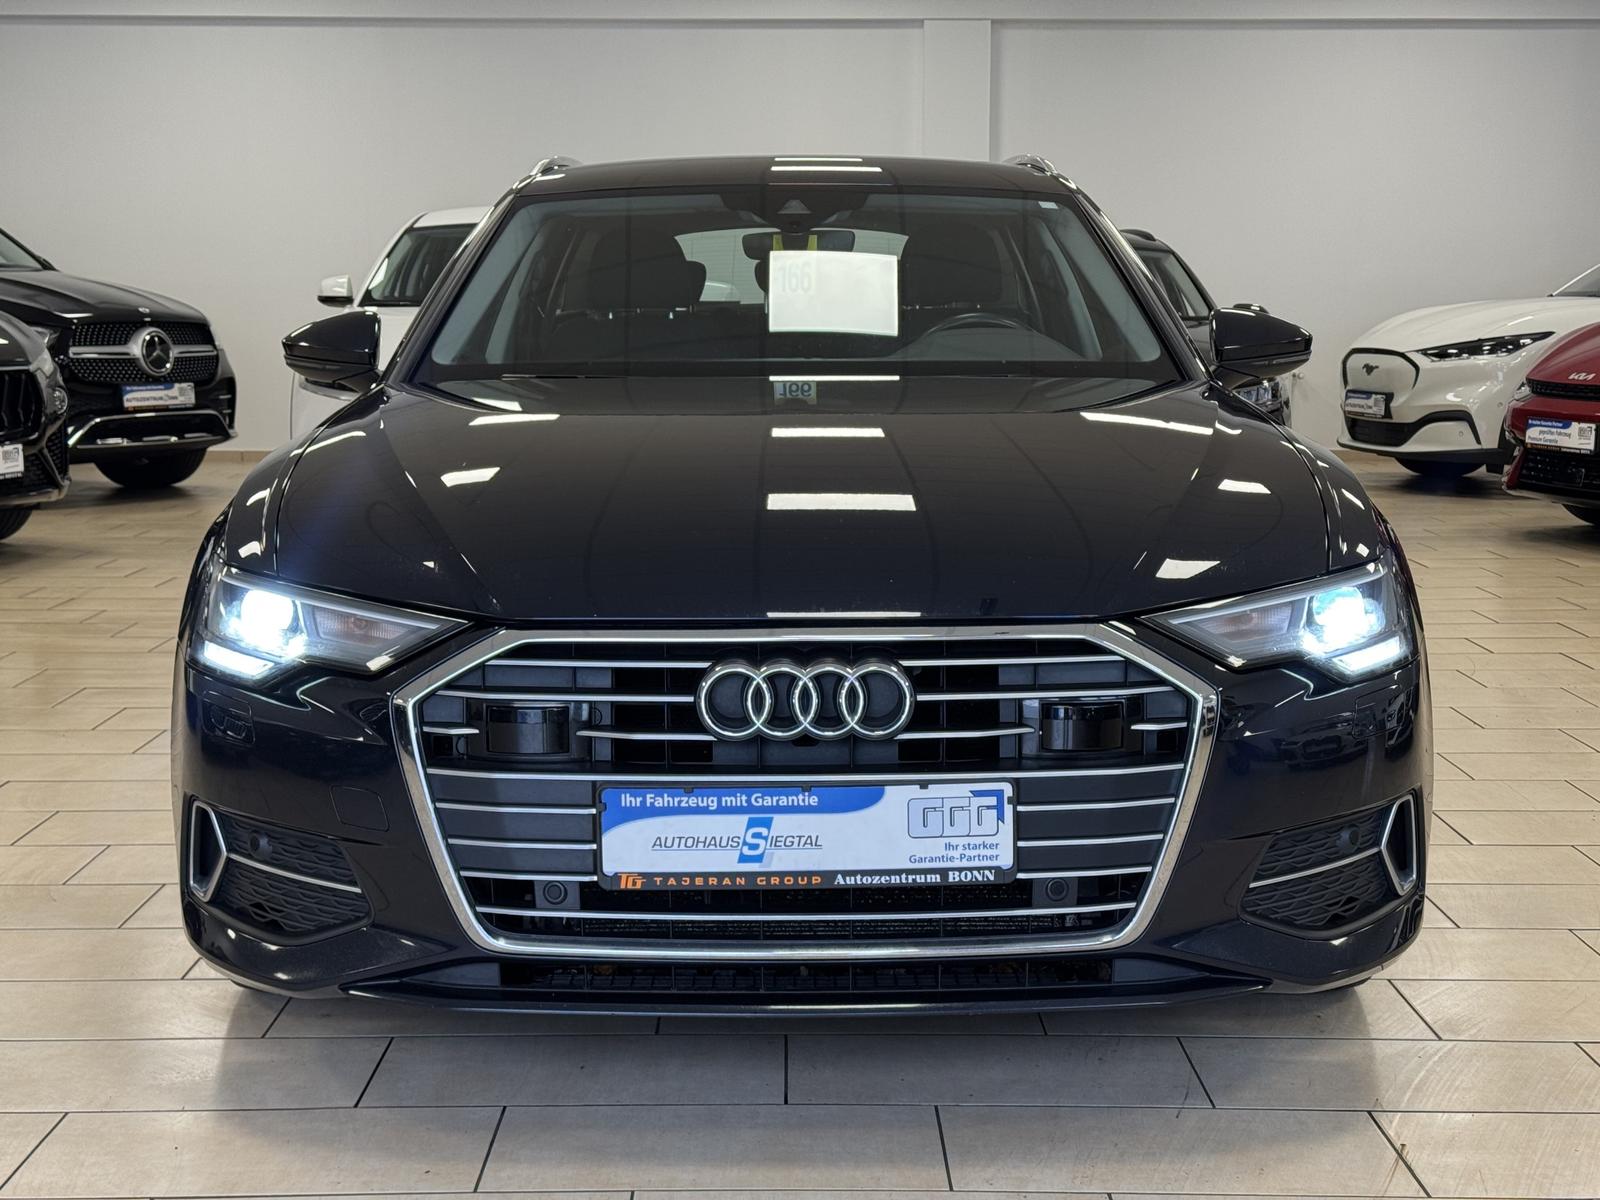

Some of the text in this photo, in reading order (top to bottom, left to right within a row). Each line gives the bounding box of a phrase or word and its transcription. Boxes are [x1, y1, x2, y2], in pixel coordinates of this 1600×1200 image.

[621, 792, 819, 810] Ihr Fahrzeug mit Garantie
[651, 835, 741, 849] AUTOHAUS
[944, 841, 1000, 852] Ihr starker
[909, 852, 1000, 864] Garantie-Partner
[653, 877, 746, 886] TAJERAN
[756, 875, 822, 886] GROUP
[833, 871, 942, 885] Autozentrum
[947, 870, 996, 882] BONN
